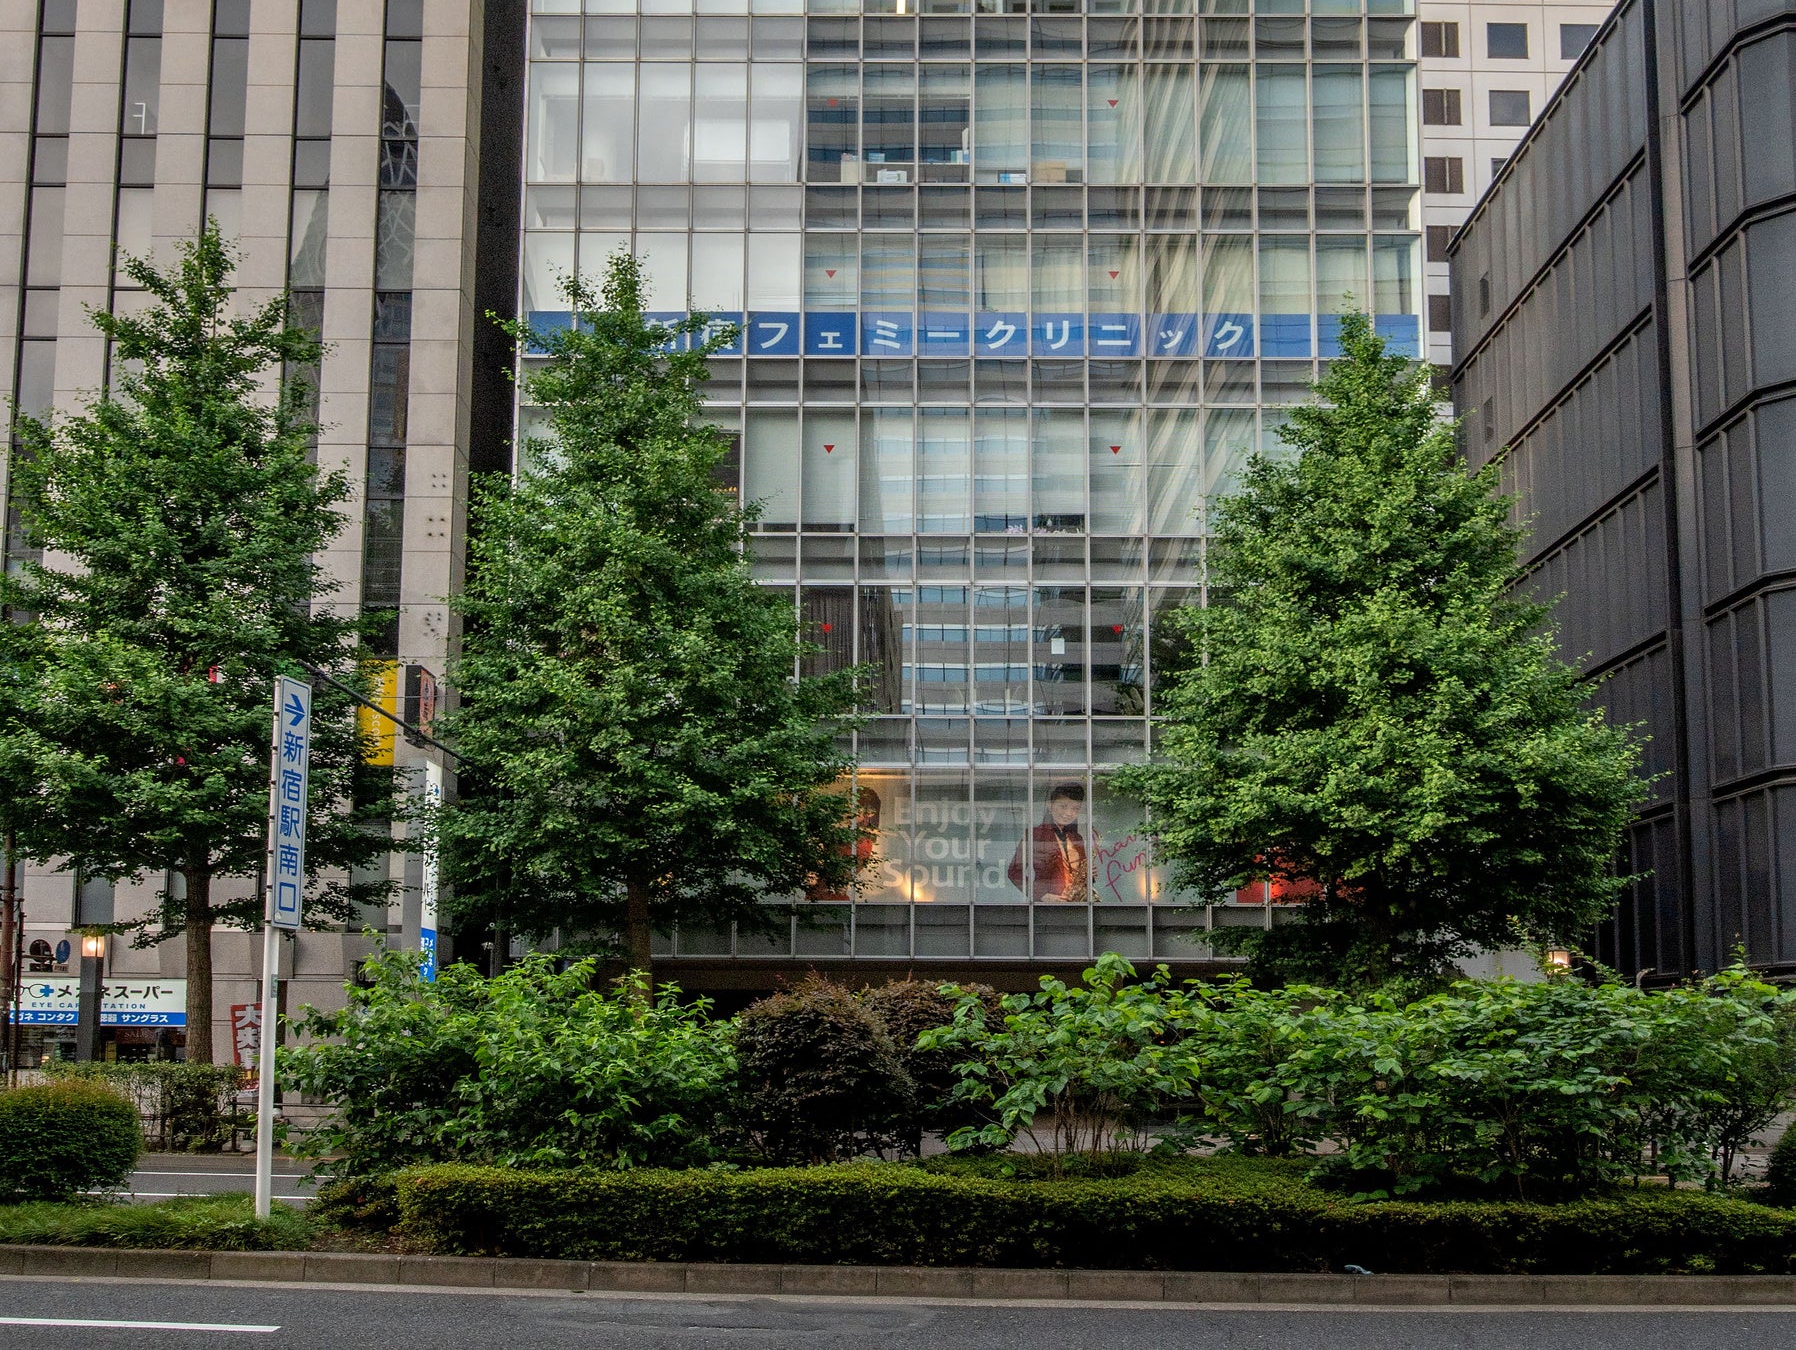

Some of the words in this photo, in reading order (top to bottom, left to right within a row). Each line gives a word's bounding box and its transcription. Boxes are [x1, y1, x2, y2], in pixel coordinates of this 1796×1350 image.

[278, 729, 304, 912] 新宿駅南口
[894, 796, 998, 834] Enjoy
[898, 830, 993, 860] Your
[1092, 832, 1147, 864] hav
[883, 858, 1008, 889] Sound
[1105, 851, 1147, 903] fun
[57, 985, 173, 1000] メネスーパー
[37, 1012, 76, 1022] コンタク
[121, 1014, 169, 1023] サングラス
